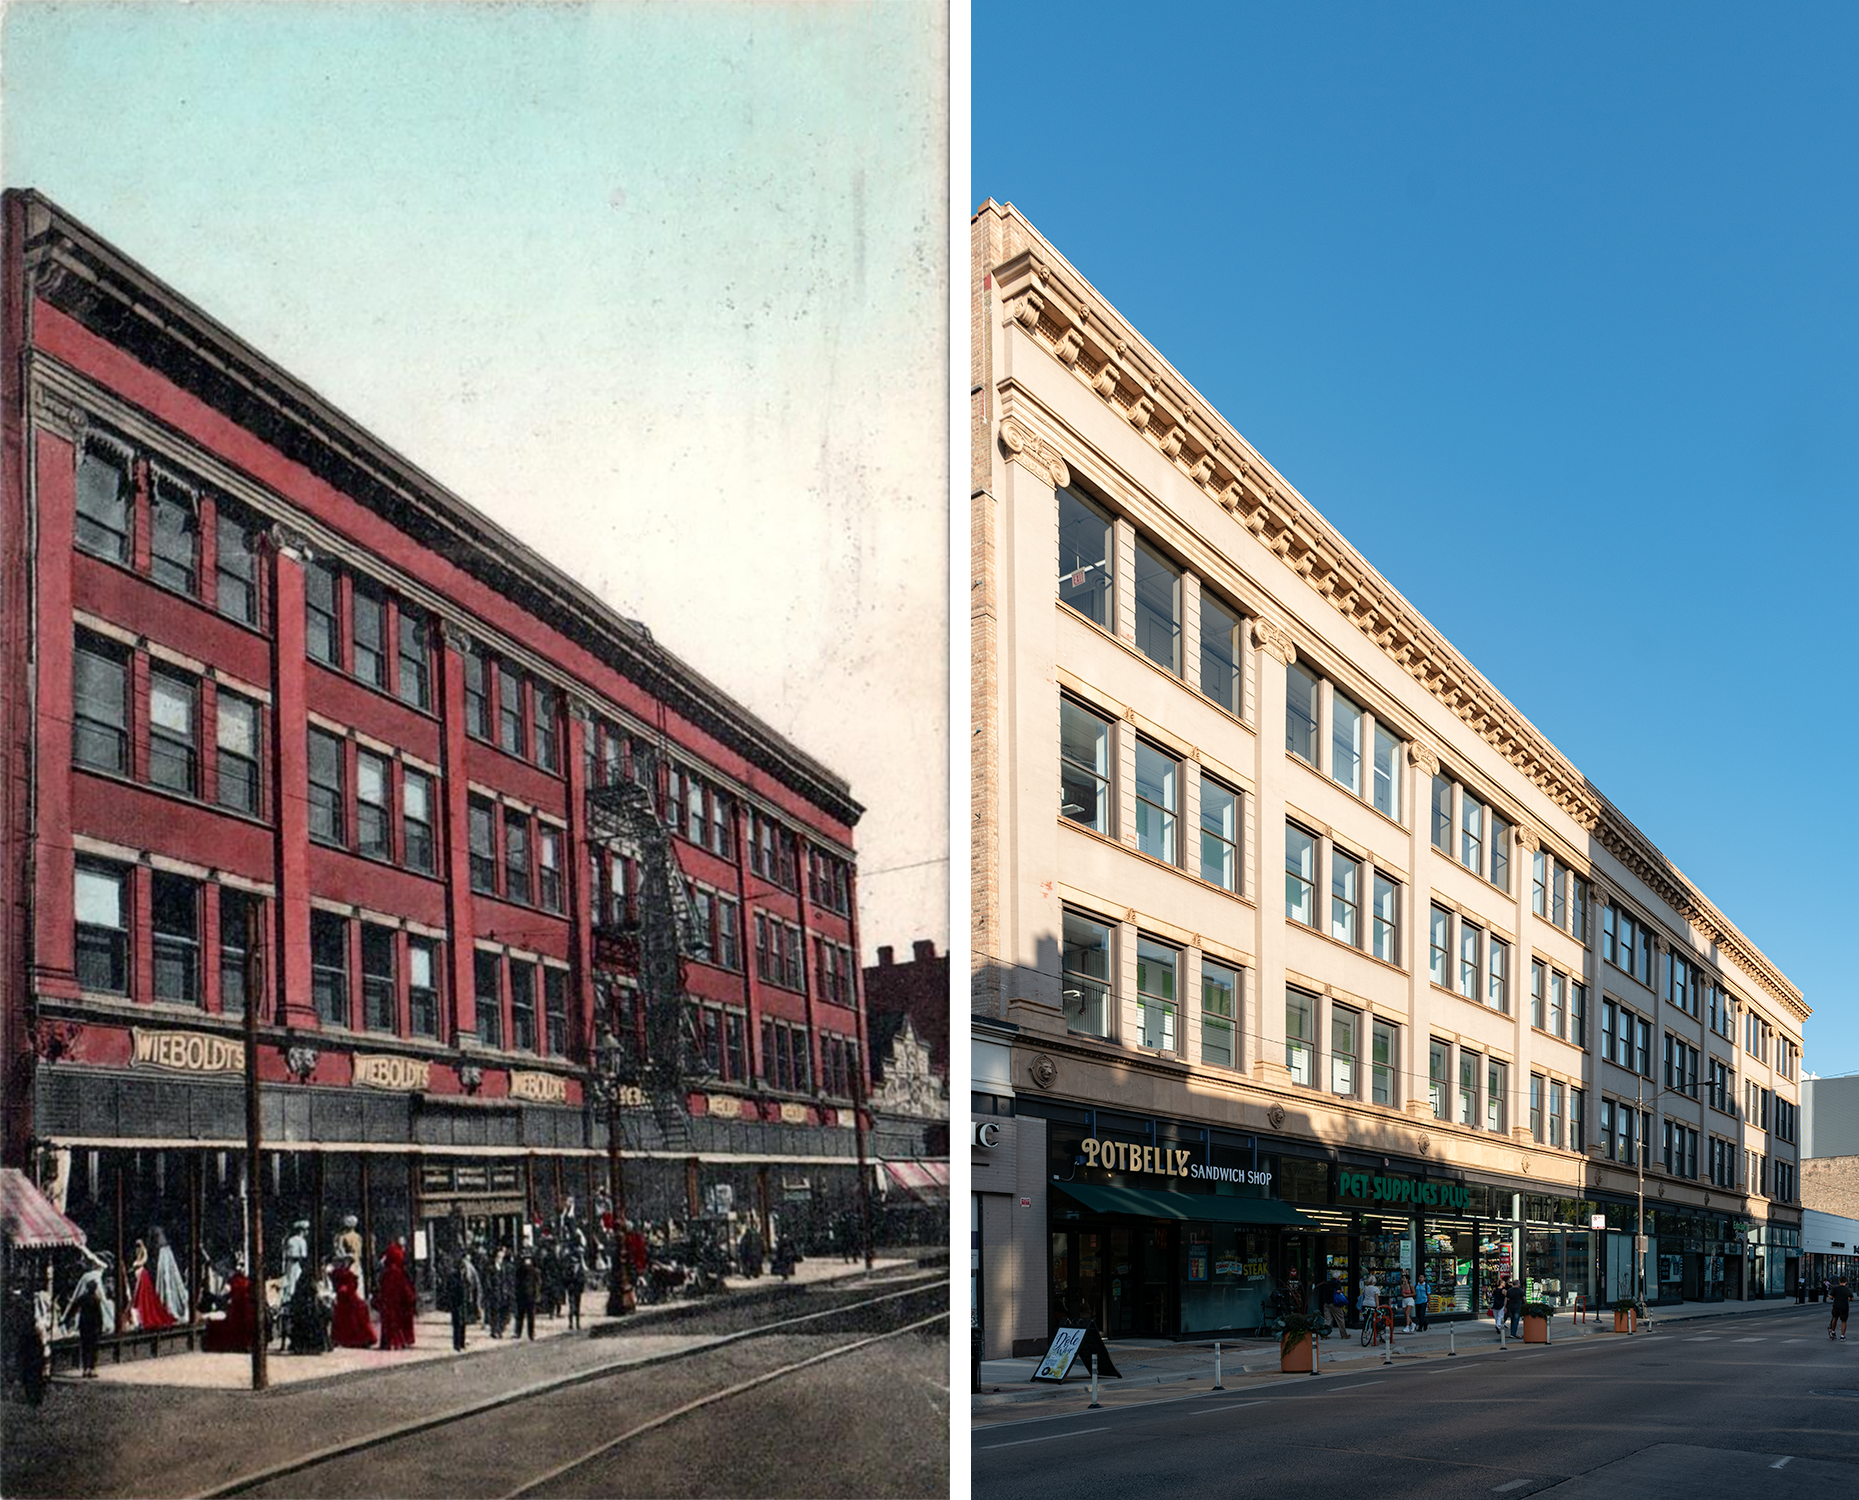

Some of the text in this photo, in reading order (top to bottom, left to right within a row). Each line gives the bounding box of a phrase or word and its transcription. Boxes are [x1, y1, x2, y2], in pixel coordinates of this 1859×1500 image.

[1073, 571, 1084, 586] EXIT
[1081, 1137, 1272, 1186] POTBELLY SANDWICH SHOP
[1340, 1171, 1470, 1209] PET SUPPLIES PLUS
[1242, 1262, 1269, 1276] STEAK
